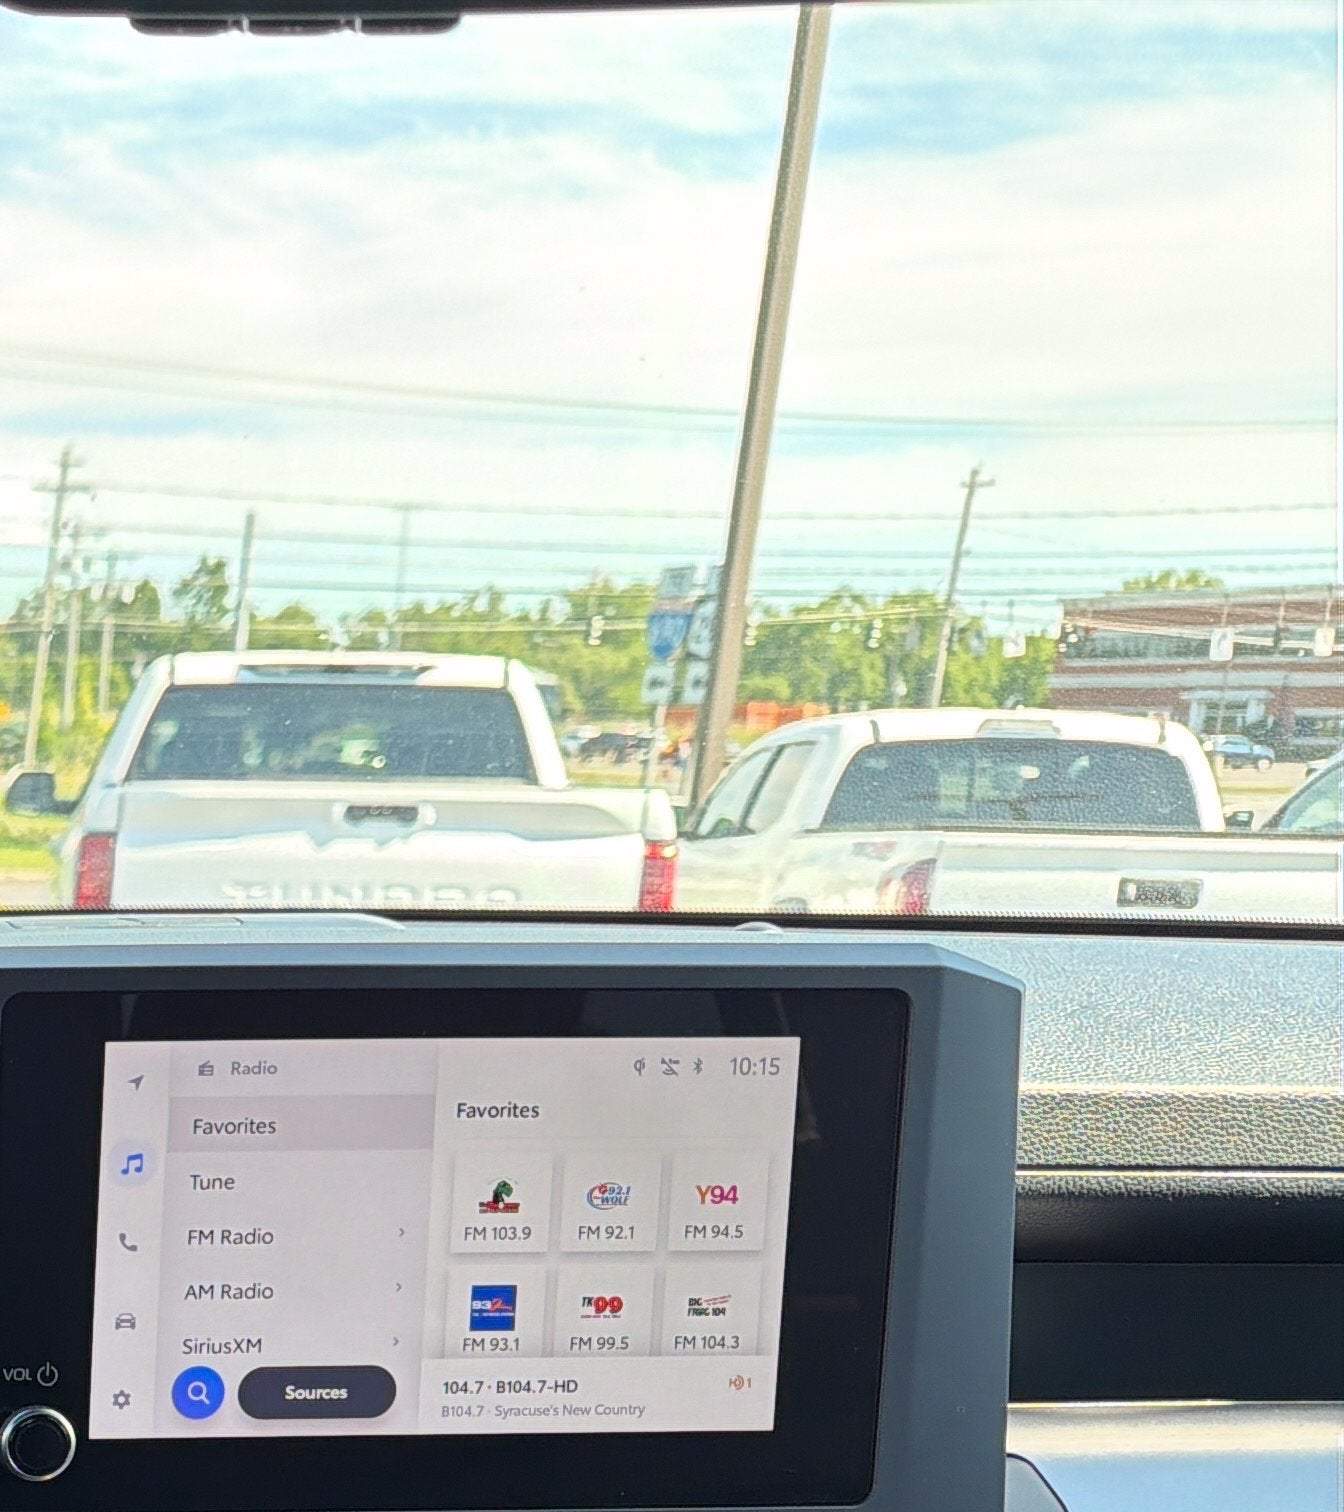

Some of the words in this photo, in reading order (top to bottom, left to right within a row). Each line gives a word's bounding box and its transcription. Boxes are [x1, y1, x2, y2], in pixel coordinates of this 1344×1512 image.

[230, 1060, 278, 1076] Radio
[729, 1056, 782, 1076] 10:15
[456, 1100, 541, 1120] Favorites
[192, 1117, 277, 1135] Favorites
[189, 1174, 236, 1191] Tune
[695, 1184, 739, 1206] Y94
[187, 1229, 215, 1246] FM
[220, 1227, 275, 1246] Radio
[463, 1226, 487, 1241] FM
[492, 1226, 532, 1241] 103.9
[578, 1225, 601, 1240] FM
[604, 1225, 635, 1240] 92.1
[684, 1224, 707, 1239] FM
[710, 1224, 744, 1239] 94.5
[183, 1284, 215, 1301] AM
[220, 1282, 275, 1300] Radio
[181, 1337, 263, 1355] SiriusXM
[462, 1337, 485, 1352] FM
[489, 1337, 520, 1352] 93.1
[570, 1336, 592, 1351] FM
[596, 1336, 629, 1351] 99.5
[674, 1335, 697, 1350] FM
[700, 1335, 741, 1350] 104.3
[2, 1366, 33, 1382] VOL
[284, 1384, 349, 1401] Sources
[442, 1380, 484, 1396] 104.7
[495, 1379, 579, 1394] B104.7-HD
[441, 1405, 484, 1418] B104.7
[494, 1403, 560, 1419] Syracuse's
[562, 1404, 592, 1417] New
[594, 1403, 646, 1418] Country
